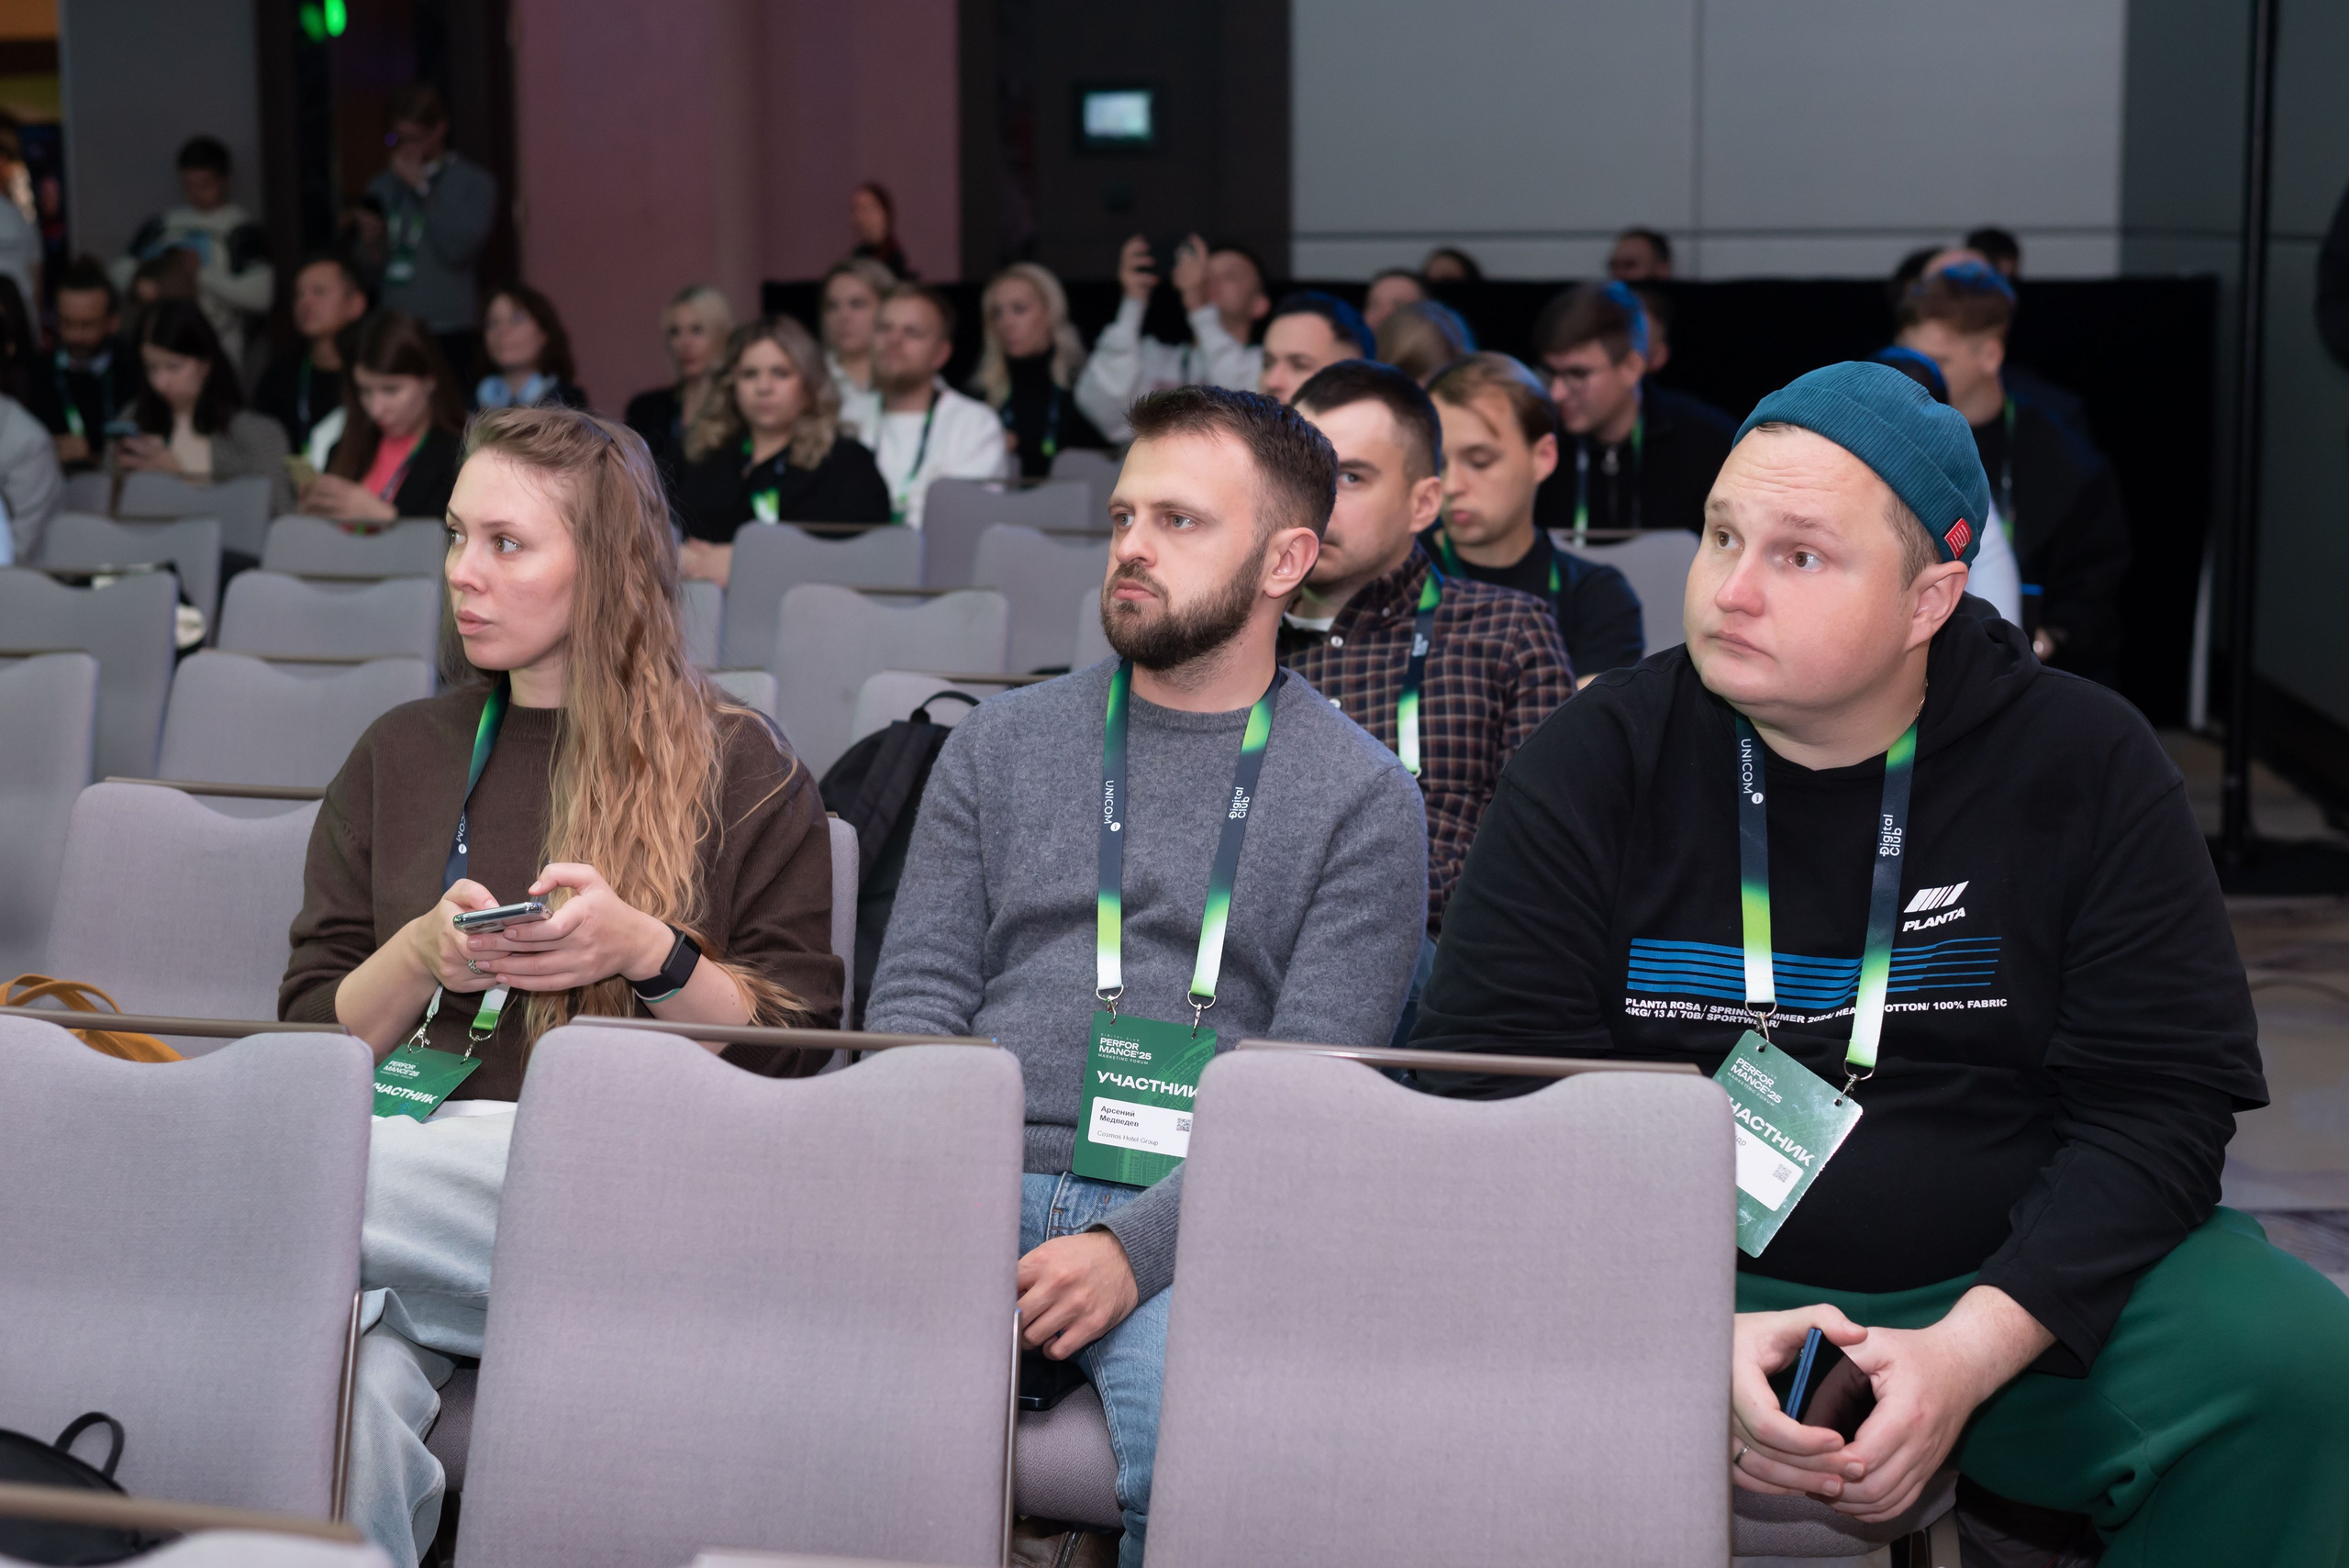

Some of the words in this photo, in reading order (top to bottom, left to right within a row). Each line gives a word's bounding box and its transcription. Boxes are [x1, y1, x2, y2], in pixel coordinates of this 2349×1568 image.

[1741, 738, 1753, 794] UNICOM
[1104, 780, 1114, 824] UNICOM
[1237, 795, 1250, 818] Club
[1889, 828, 1902, 856] Club
[1902, 906, 1966, 932] PLANTA
[1625, 997, 1668, 1009] PLANTA
[1670, 1001, 1701, 1012] ROSA
[1807, 1012, 1835, 1024] 2024/
[1884, 1002, 1930, 1012] OTTON/
[1932, 1000, 1965, 1010] 100%
[1966, 998, 2008, 1009] FABRIC
[1625, 1006, 1652, 1018] 4KG/
[1653, 1009, 1665, 1018] 13
[1680, 1010, 1705, 1020] 70B/
[1098, 1044, 1152, 1061] MANCE'25
[1099, 1037, 1140, 1051] PERFOR
[388, 1060, 416, 1071] PERFOR
[1097, 1052, 1129, 1062] MARKETING
[1731, 1063, 1783, 1104] MANCE'25
[1735, 1056, 1775, 1088] PERFOR
[1727, 1072, 1756, 1094] MARKETING
[1756, 1092, 1776, 1107] FORUM
[1099, 1114, 1140, 1128] Медведев
[1100, 1106, 1136, 1118] Арсений
[1097, 1129, 1122, 1140] Cosmos
[1122, 1134, 1139, 1143] Hotel
[1140, 1137, 1159, 1147] Group
[1728, 1096, 1816, 1168] ЧАСТНИК
